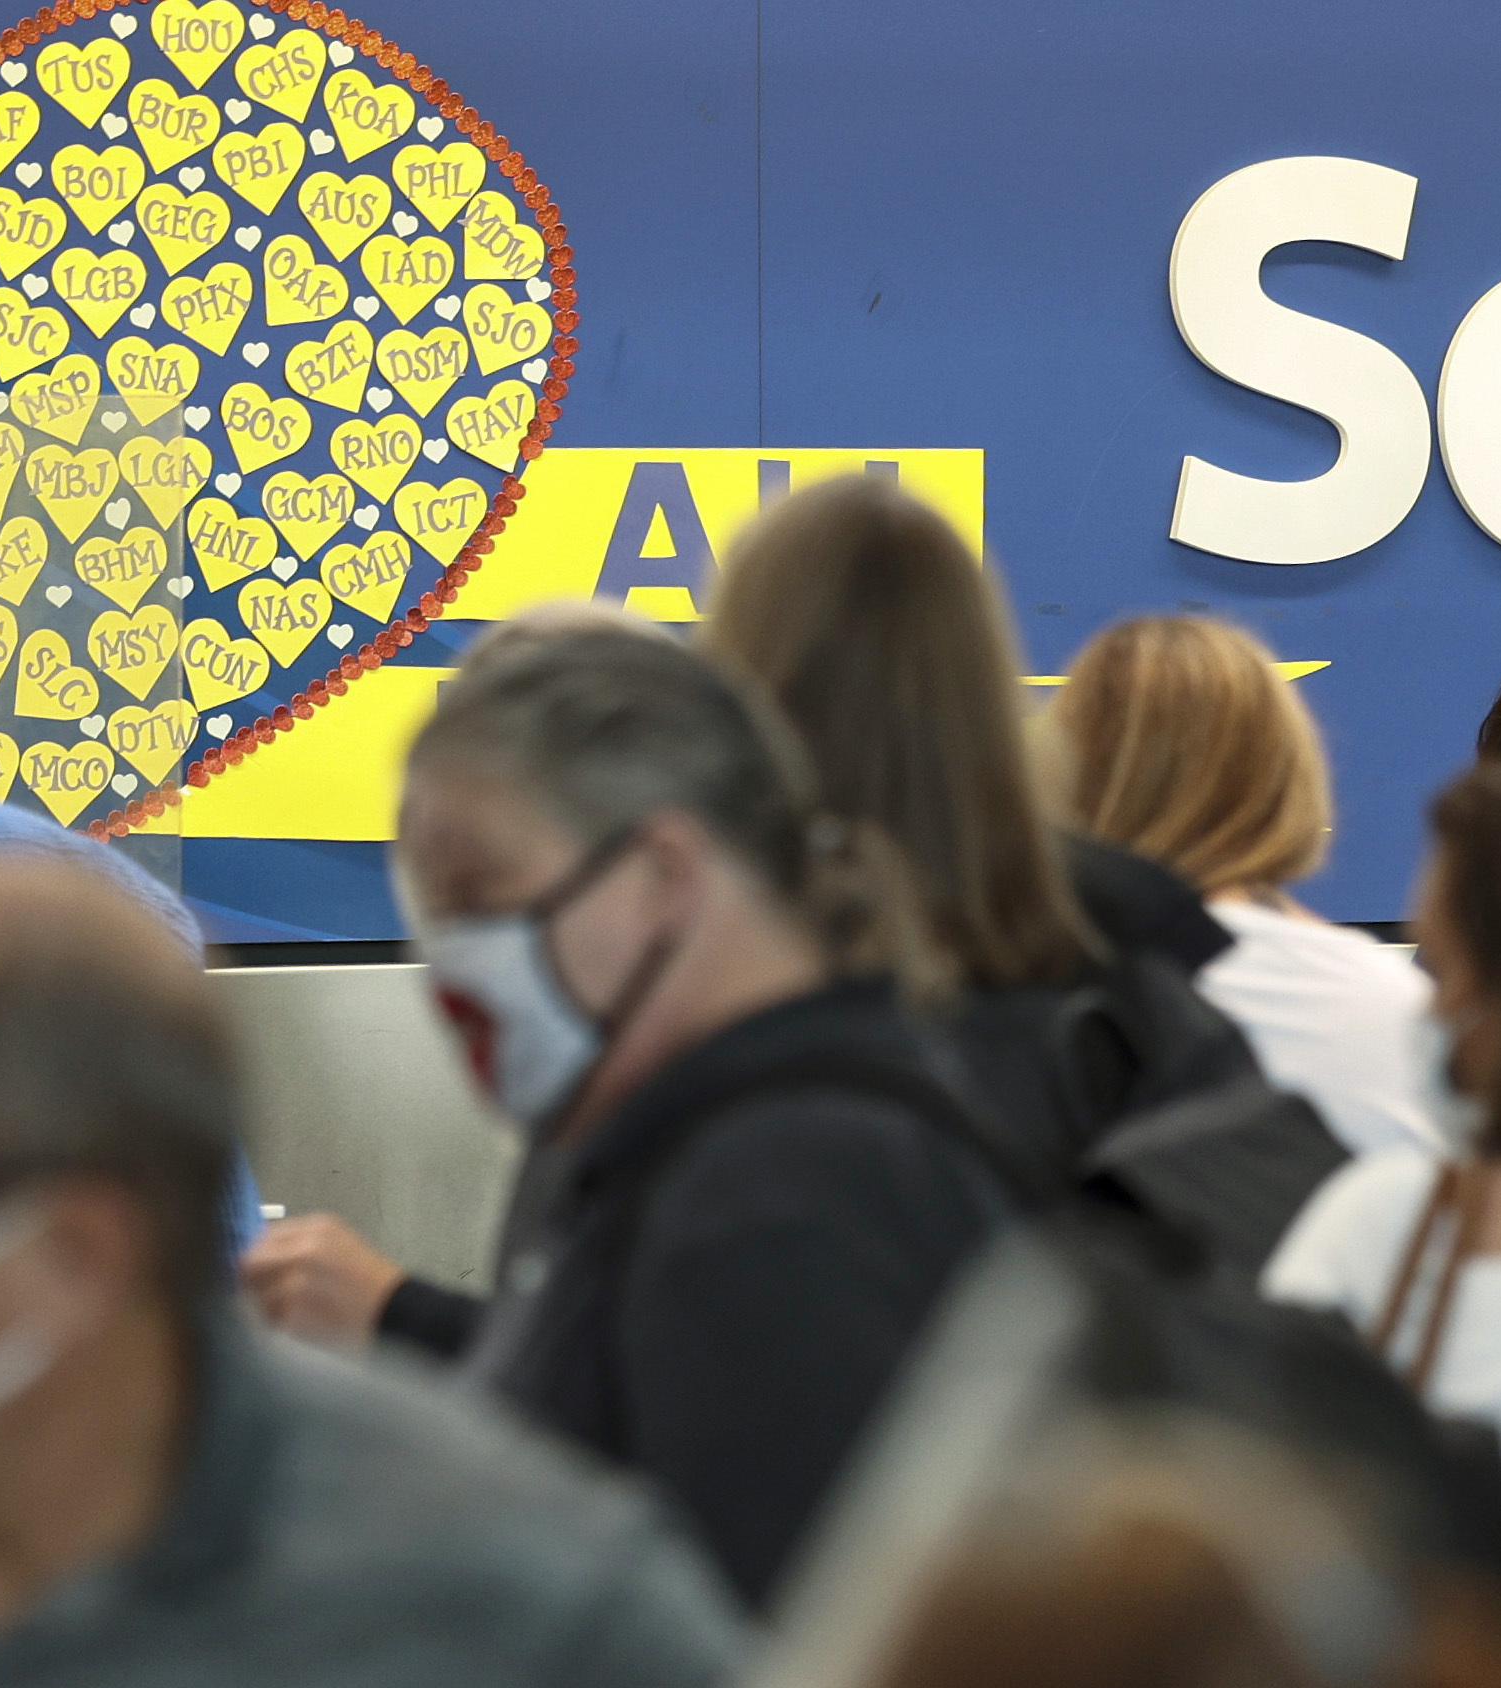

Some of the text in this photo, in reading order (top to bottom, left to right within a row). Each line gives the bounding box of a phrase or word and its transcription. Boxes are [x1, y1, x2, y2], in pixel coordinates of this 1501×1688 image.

[159, 20, 233, 53] HOU
[43, 54, 114, 95] TUS
[248, 47, 316, 97] CHS
[133, 94, 208, 144] BUR
[327, 82, 401, 137] KOA
[62, 166, 128, 201] BOI
[222, 136, 288, 188] PBI
[406, 162, 476, 199] PHL
[143, 200, 217, 245] GEG
[307, 186, 377, 229] AUS
[459, 198, 542, 278] MDW
[62, 266, 137, 300] LGB
[269, 247, 337, 317] OAK
[379, 251, 447, 284] IAD
[172, 277, 249, 332] PHX
[473, 302, 536, 352] SJO
[118, 353, 187, 394] SNA
[295, 334, 370, 398] BZE
[386, 340, 466, 382] DSM
[20, 370, 90, 427] MSP
[452, 396, 527, 446] HAV
[223, 398, 296, 450] BOS
[128, 452, 207, 489] LGA
[341, 432, 414, 470] RNO
[28, 458, 109, 499] MBJ
[266, 487, 352, 523] GCM
[413, 494, 476, 534] ICT
[78, 540, 166, 585] BHM
[193, 512, 262, 570] HNL
[328, 543, 412, 595] CMH
[250, 594, 318, 631] NAS
[98, 619, 170, 671] MSY
[184, 638, 261, 692] CUN
[26, 646, 90, 710] SLC
[115, 717, 201, 752] DTW
[27, 755, 108, 791] MCO
